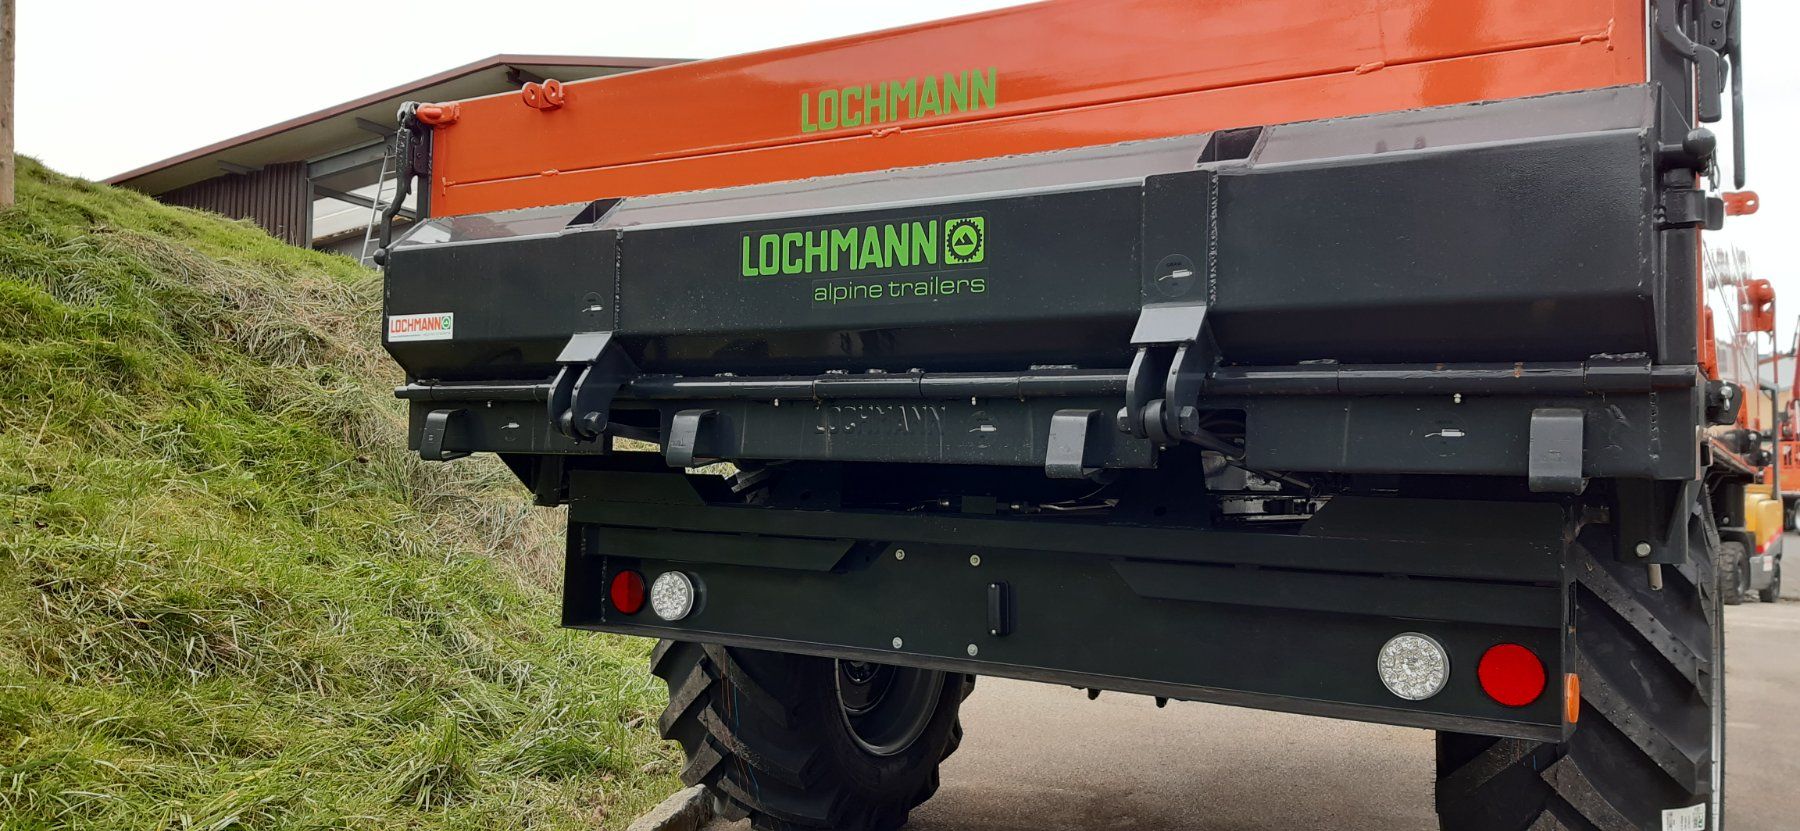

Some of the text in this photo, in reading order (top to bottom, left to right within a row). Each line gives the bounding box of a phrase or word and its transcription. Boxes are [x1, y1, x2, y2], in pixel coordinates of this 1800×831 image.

[801, 66, 997, 133] LOCHMANN
[742, 219, 938, 277] LOCHMANN
[813, 276, 986, 305] alpine trailers
[391, 316, 441, 333] LOCHMANN
